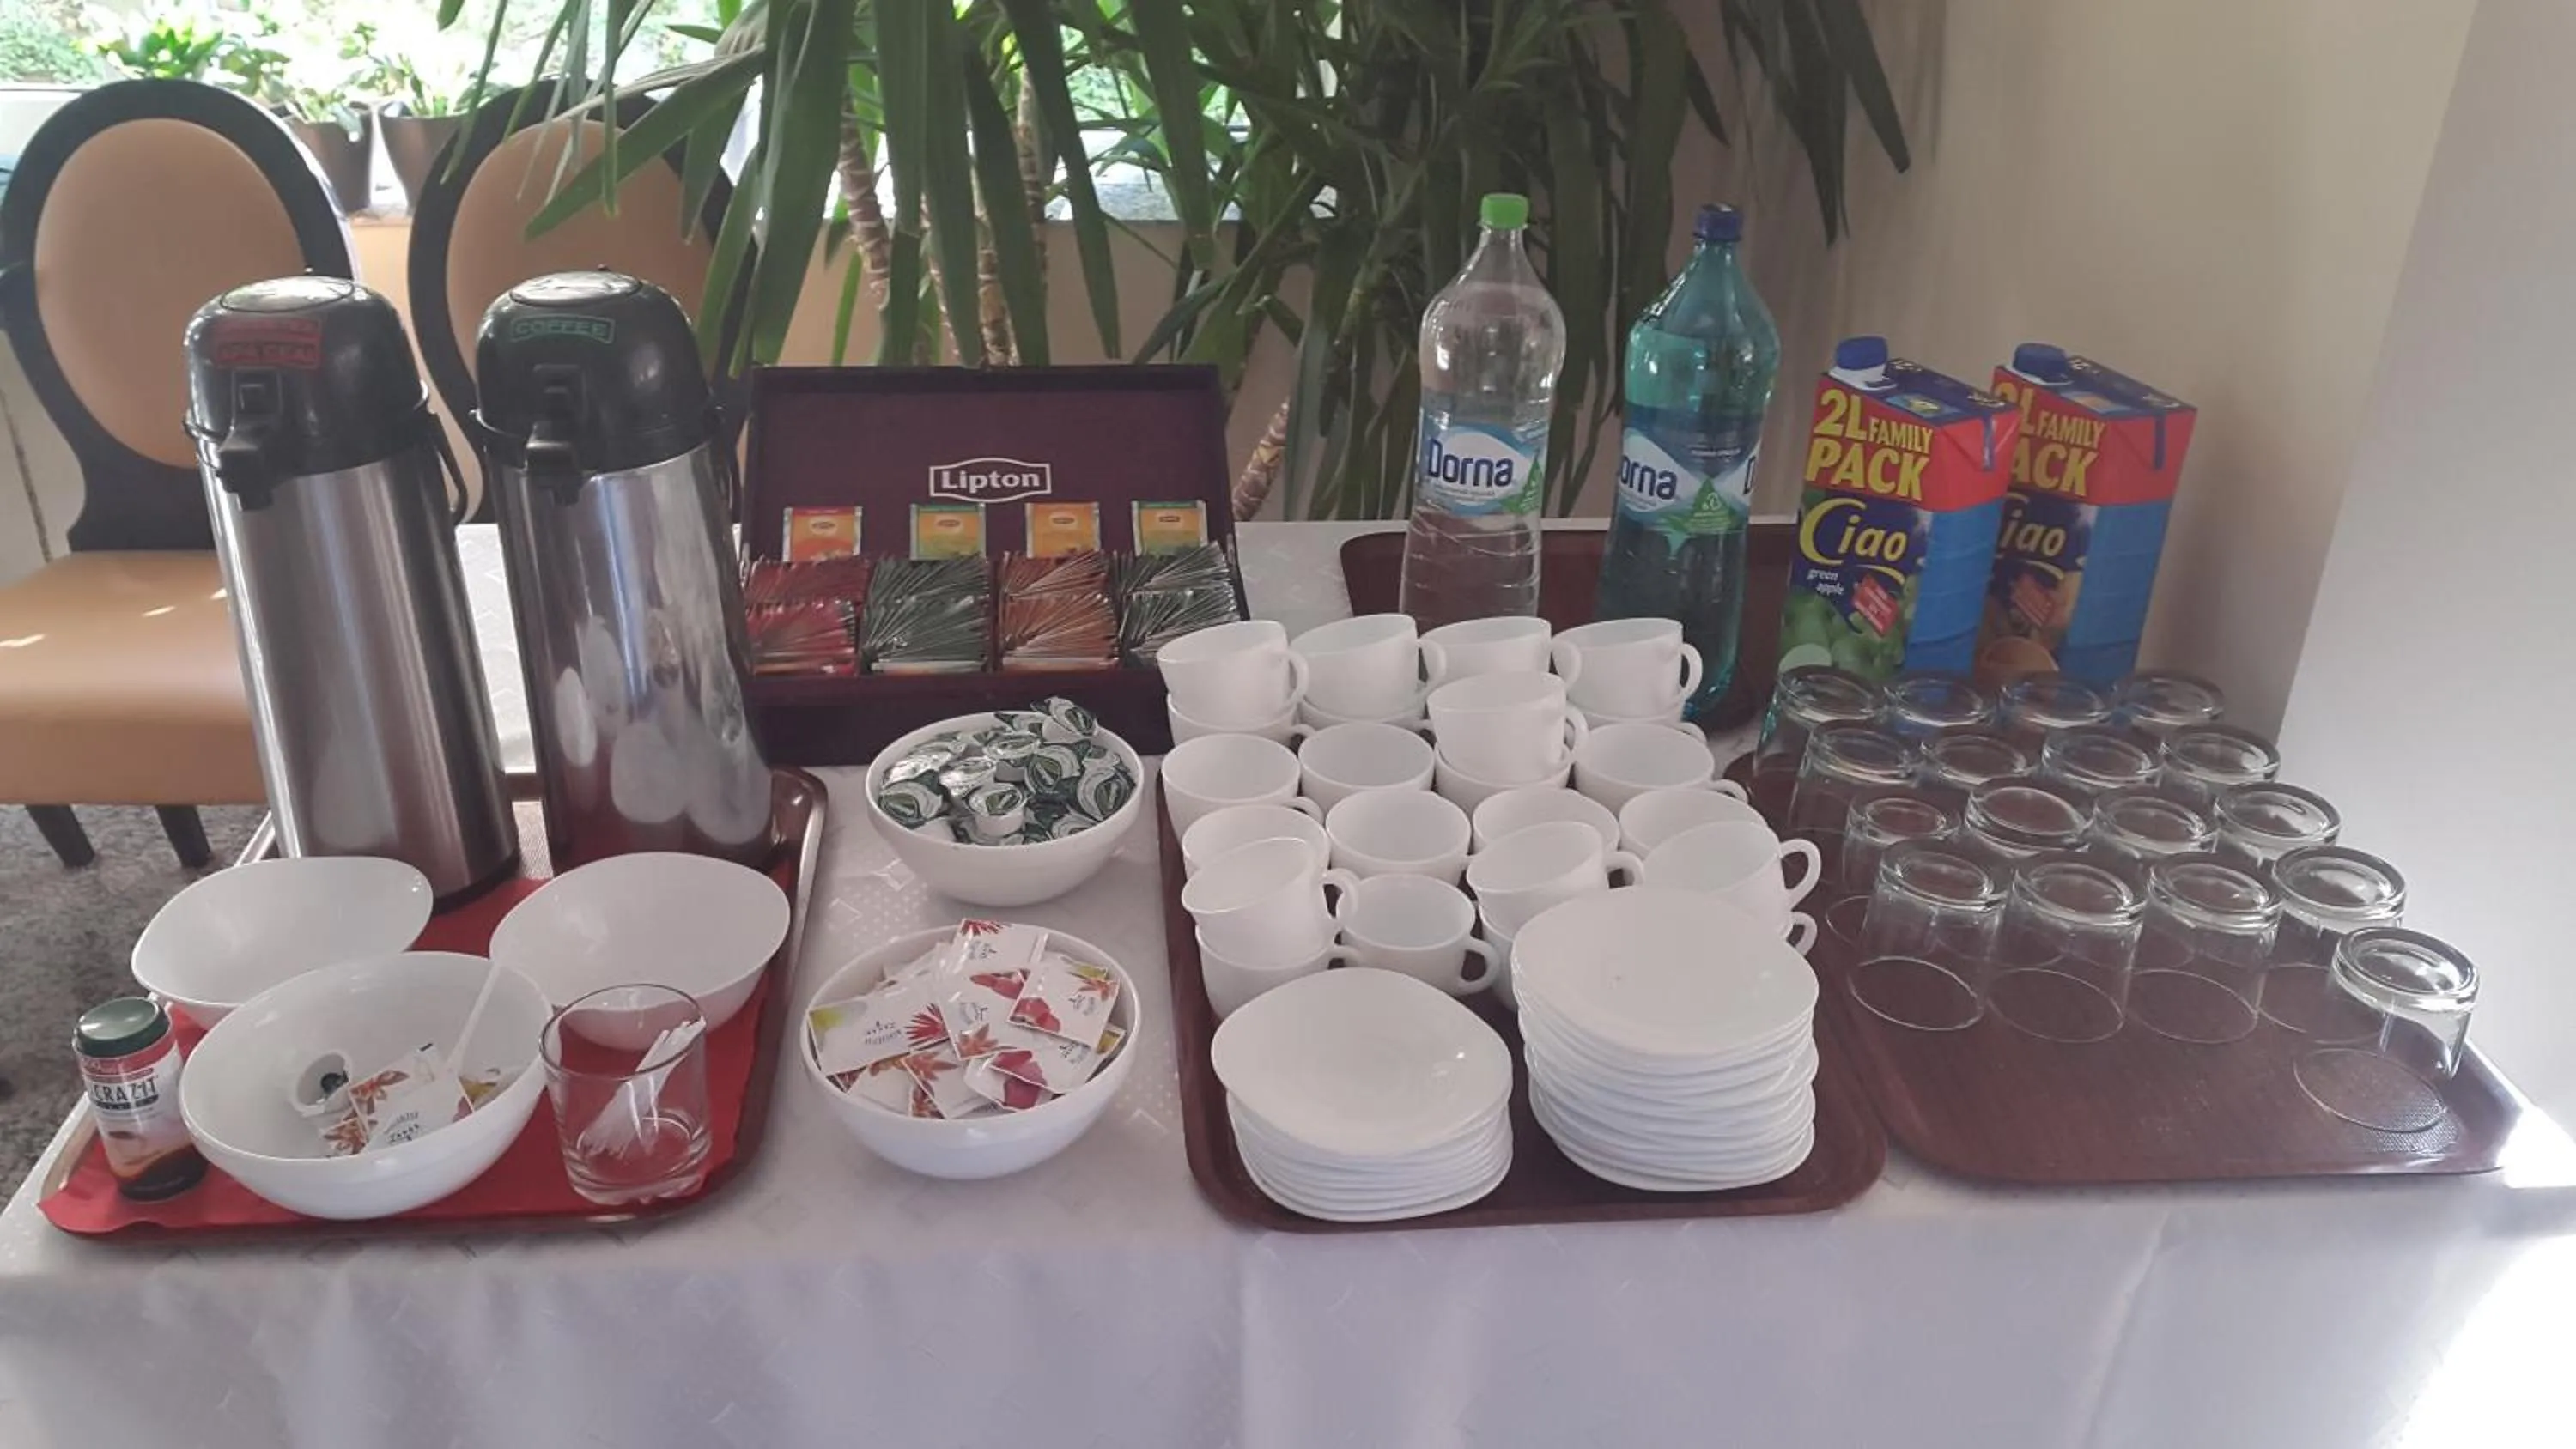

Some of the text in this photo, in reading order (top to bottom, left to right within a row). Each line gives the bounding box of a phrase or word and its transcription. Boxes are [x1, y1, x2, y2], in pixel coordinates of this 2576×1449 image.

[515, 318, 608, 339] COFFEE
[1813, 389, 1933, 456] 2L FAMILY
[2038, 409, 2105, 449] FAMILY
[941, 470, 1041, 494] Lipton
[1427, 437, 1514, 488] Dorna
[1620, 454, 1678, 500] orna
[1806, 437, 1930, 502] PACK
[2010, 438, 2100, 498] ACK
[1798, 497, 1908, 567] Ciao
[1807, 568, 1839, 582] green
[1815, 582, 1845, 597] apple
